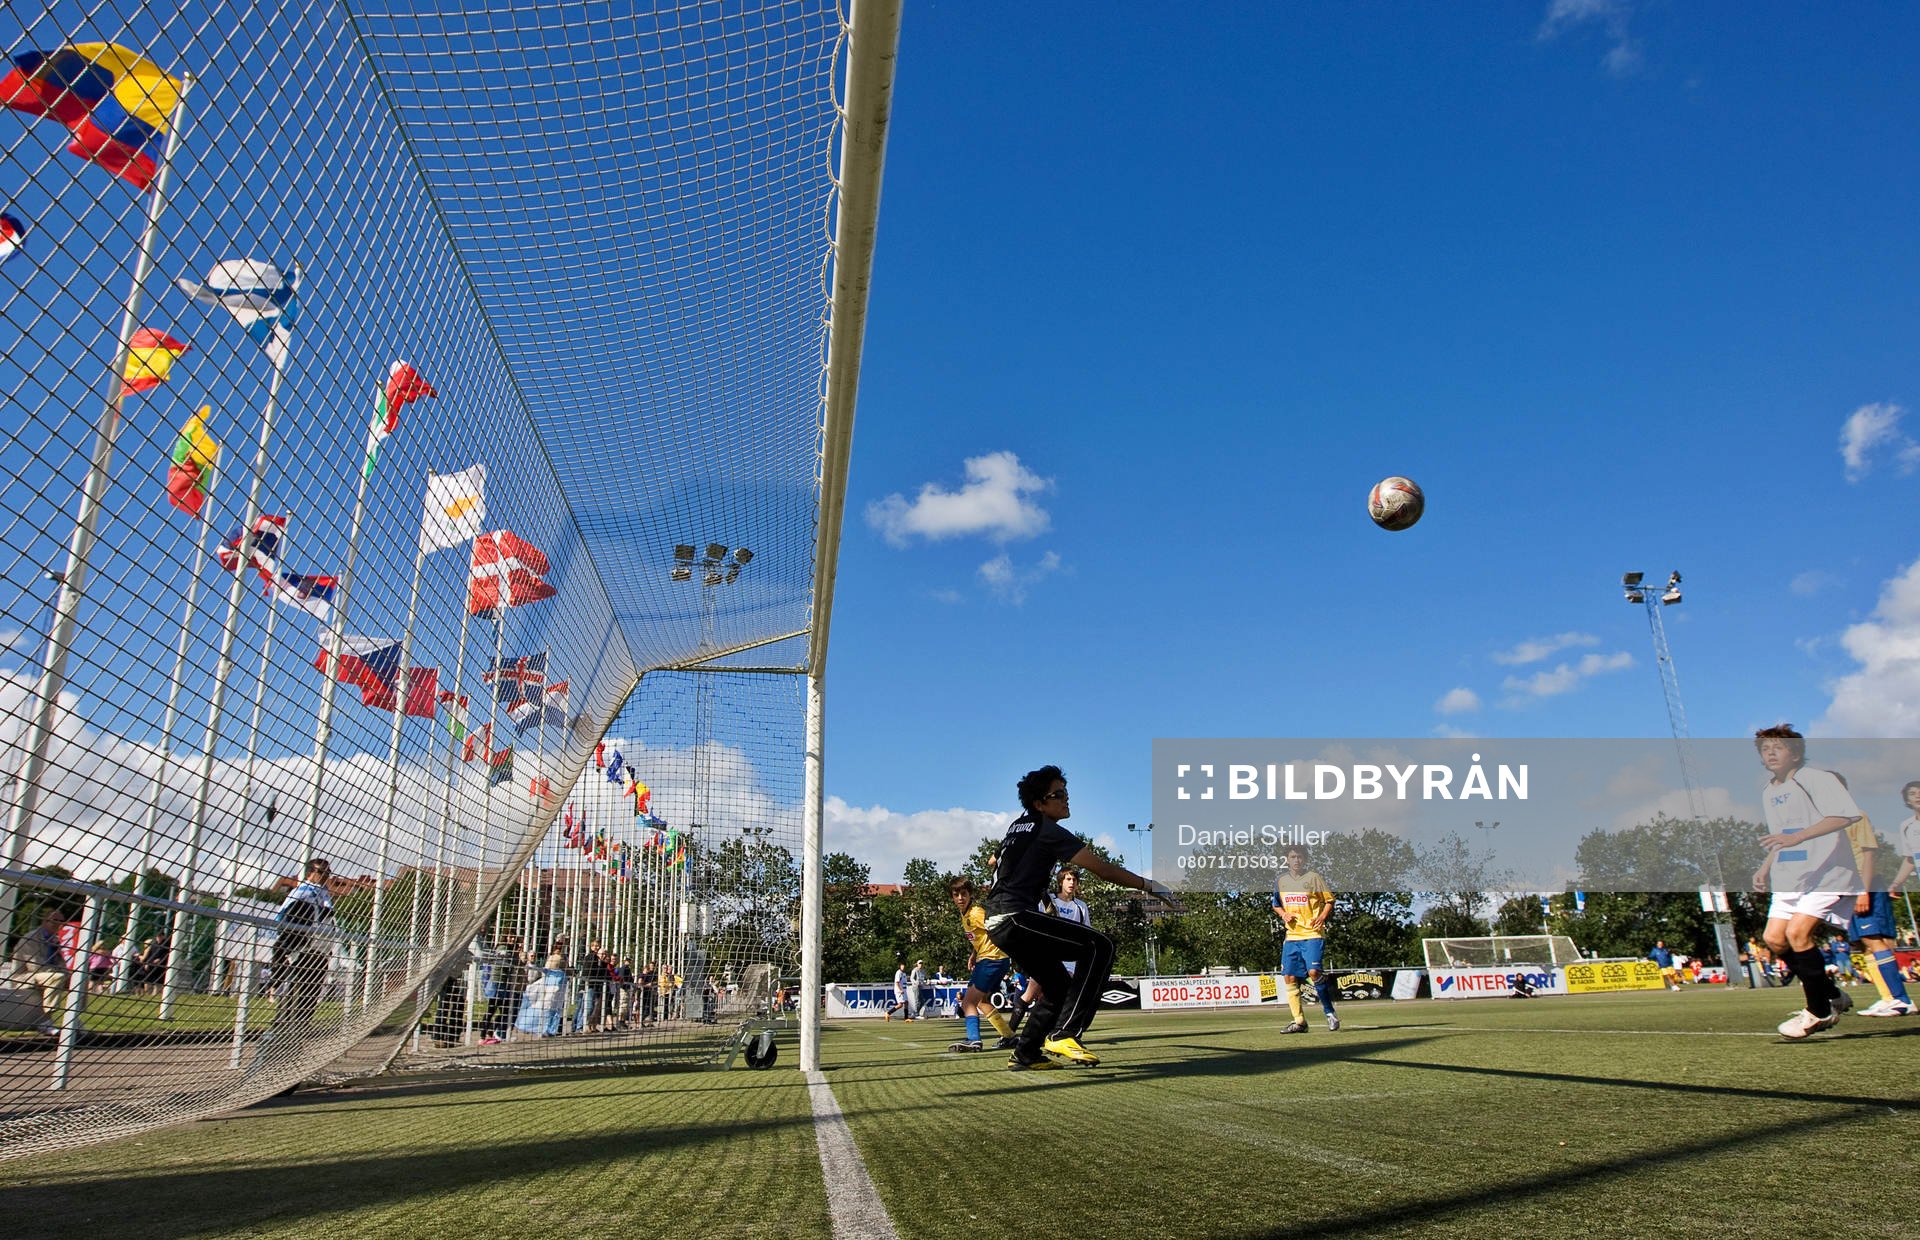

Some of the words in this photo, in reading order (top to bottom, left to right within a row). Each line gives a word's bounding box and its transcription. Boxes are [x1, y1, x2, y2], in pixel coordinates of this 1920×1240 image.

[1337, 973, 1383, 989] KOPPARBERG
[1456, 973, 1556, 991] INTERSORT
[1152, 986, 1221, 1002] 0200-230
[1224, 985, 1250, 999] 230
[844, 998, 896, 1014] KPMG
